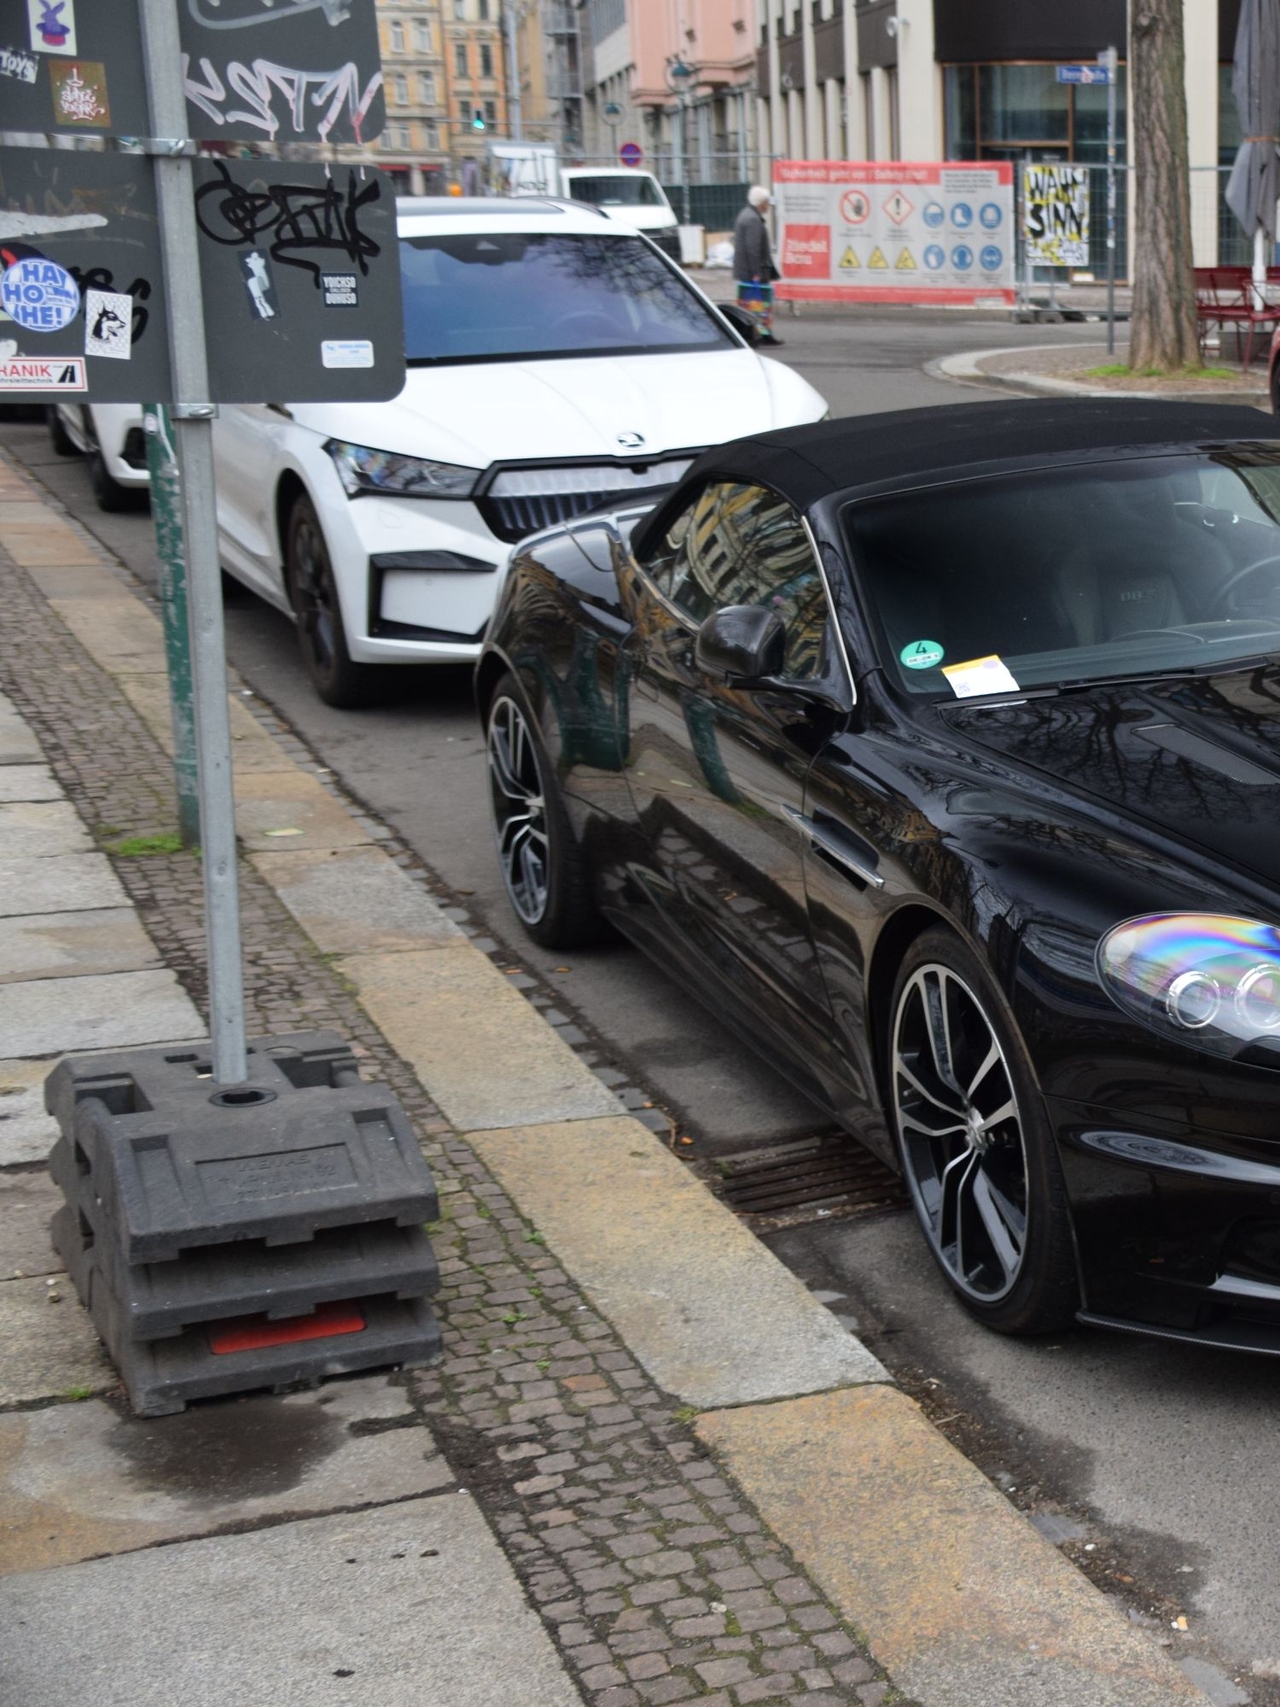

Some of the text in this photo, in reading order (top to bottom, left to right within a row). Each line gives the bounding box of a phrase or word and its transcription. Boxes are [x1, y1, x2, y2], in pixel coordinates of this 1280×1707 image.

[1026, 203, 1083, 240] SINN
[21, 263, 61, 286] HA
[3, 283, 45, 304] HO
[21, 305, 64, 328] HE!
[915, 642, 927, 654] 4
